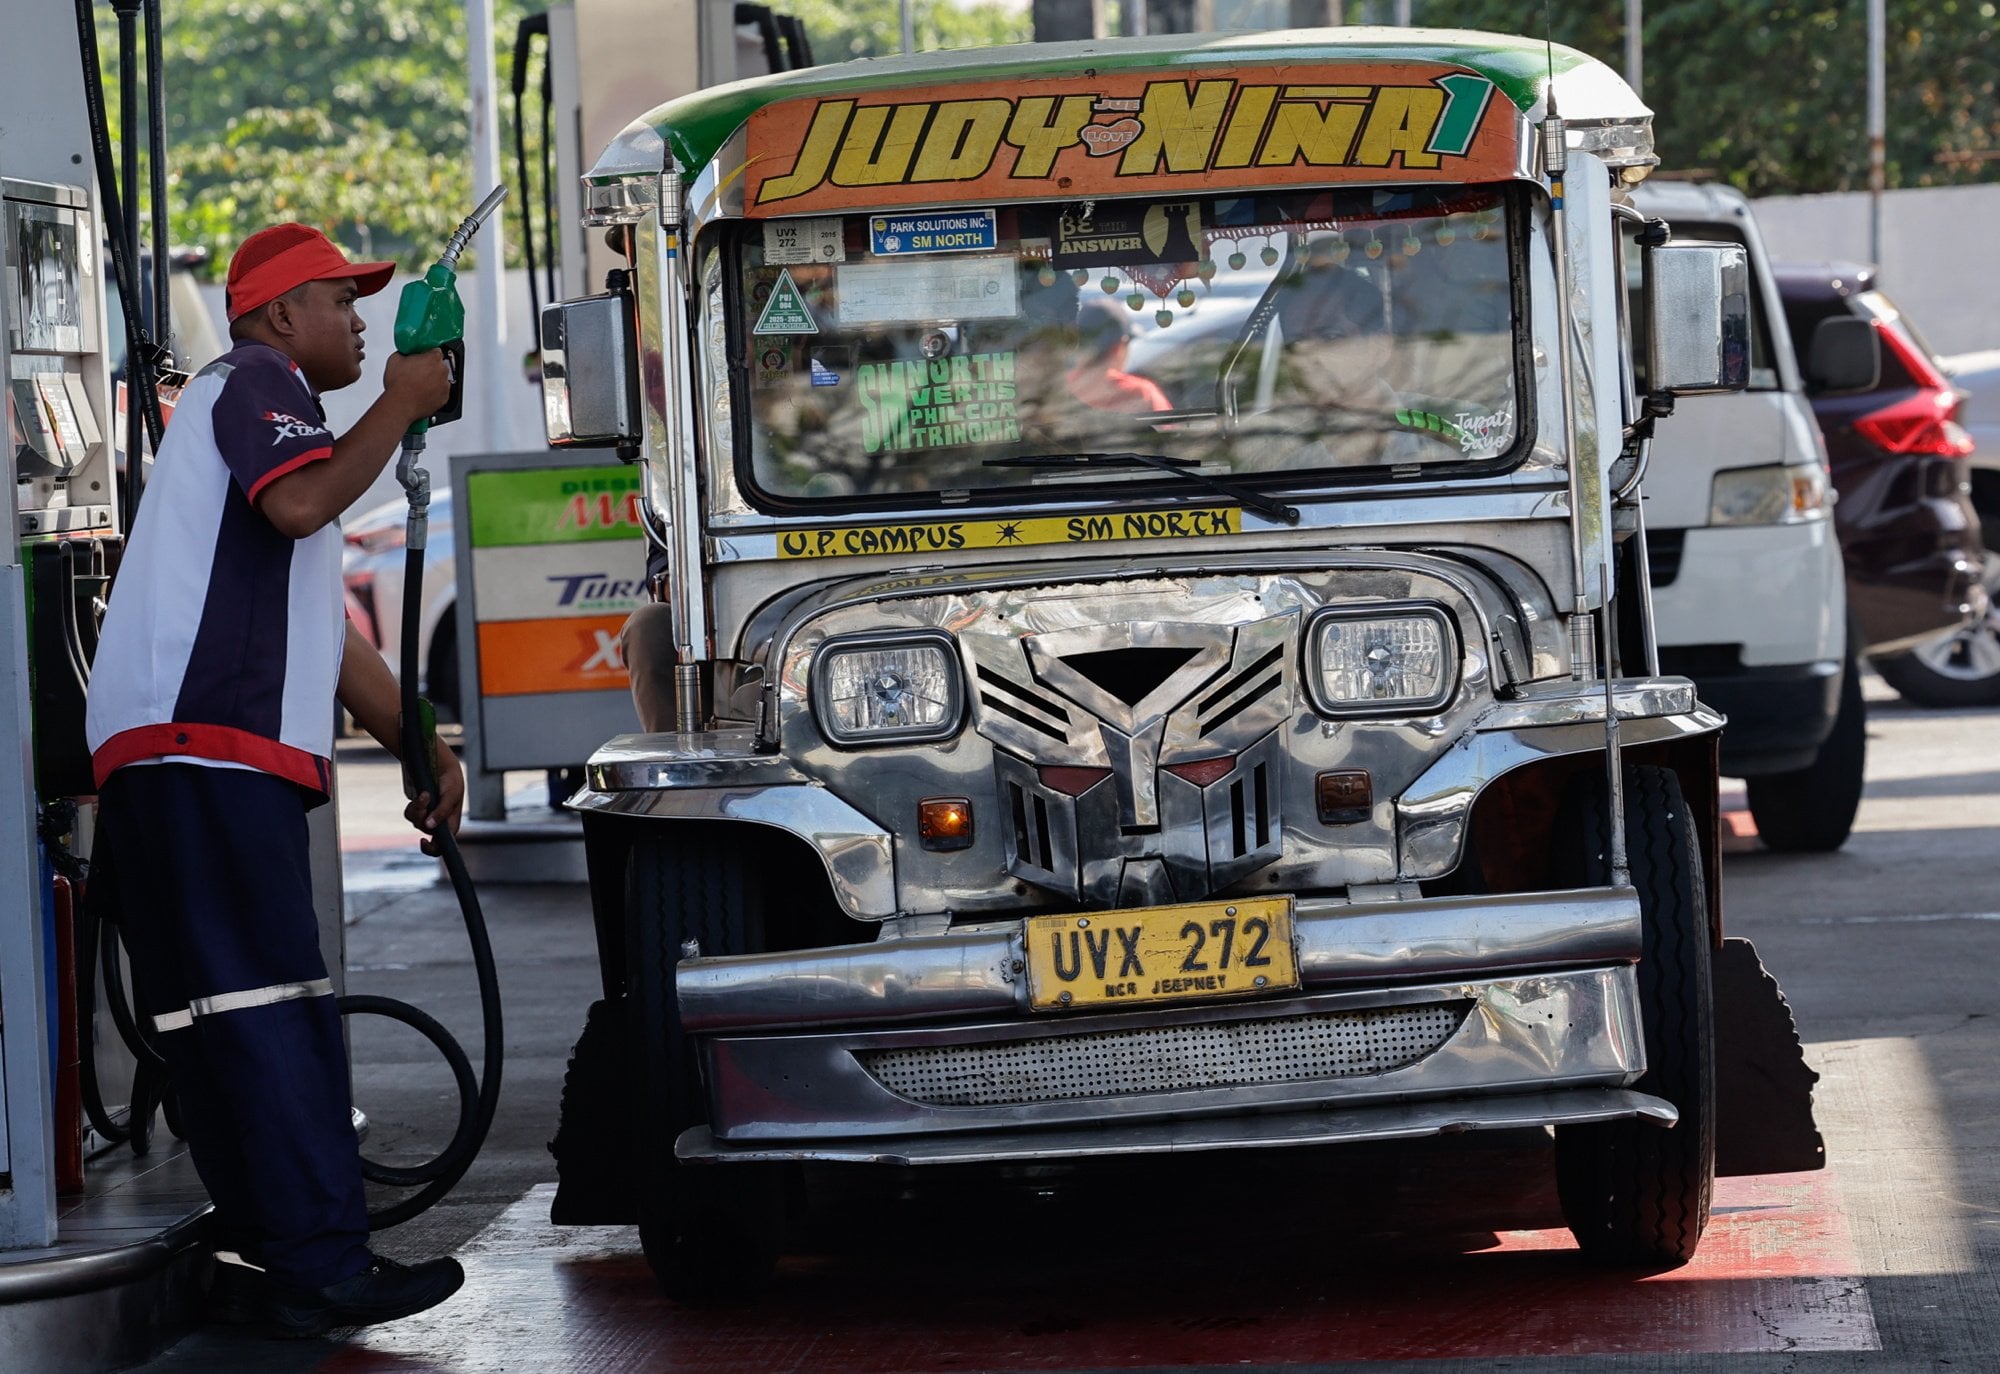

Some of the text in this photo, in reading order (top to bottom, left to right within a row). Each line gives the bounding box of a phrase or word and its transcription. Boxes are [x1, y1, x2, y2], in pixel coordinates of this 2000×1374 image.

[754, 72, 1497, 206] JUDY NIÑA 1
[1086, 131, 1133, 142] LOVE
[776, 228, 798, 237] UVX
[890, 217, 988, 233] PARK SOLUTIONS INC.
[778, 238, 797, 247] 272
[912, 232, 983, 248] SM NORTH
[1059, 237, 1143, 254] ANSWER
[906, 352, 1016, 388] NORTH
[911, 383, 1017, 406] VERTIS
[858, 361, 912, 453] SM
[910, 402, 1018, 426] PHILCOA
[911, 419, 1021, 448] TRINOMA
[1455, 409, 1506, 434] Tapat
[272, 423, 327, 446] XTRA
[783, 509, 1231, 557] U.P. CAMPUS SM NORTH
[1053, 917, 1272, 981] UVX 272
[1105, 974, 1227, 998] NCR JEEPNEY
